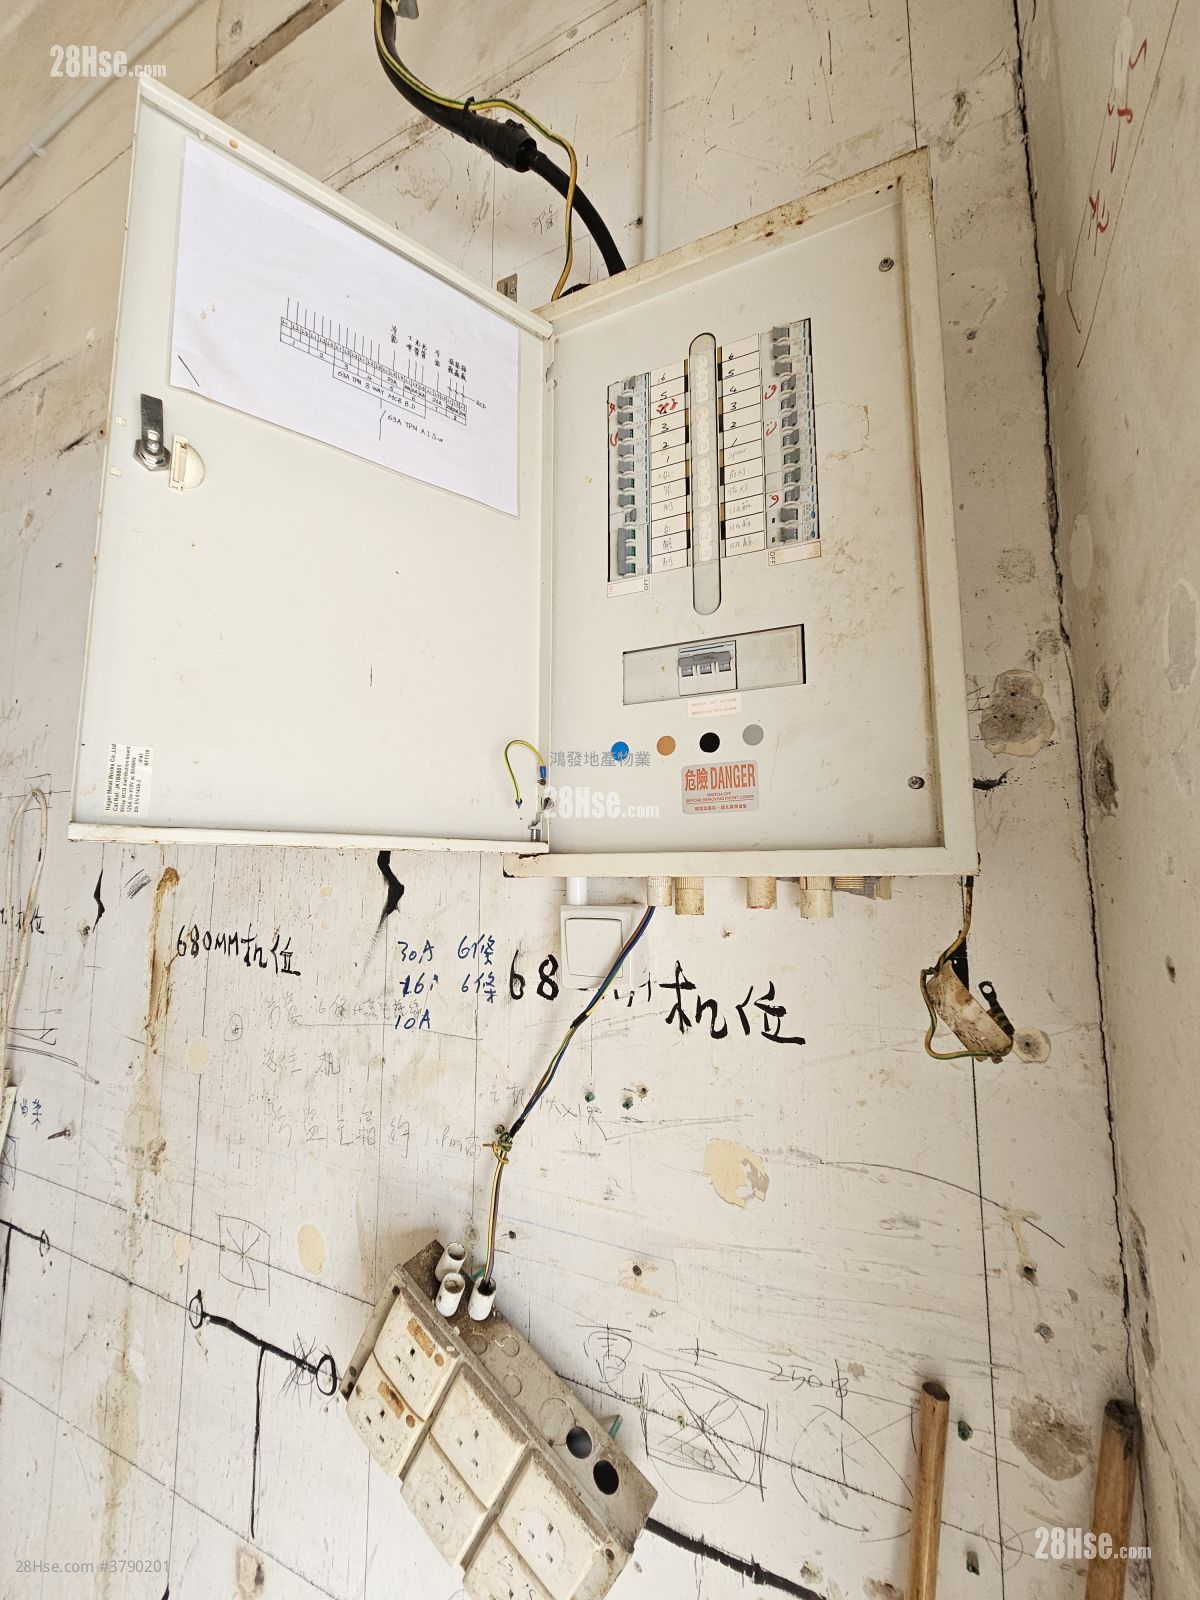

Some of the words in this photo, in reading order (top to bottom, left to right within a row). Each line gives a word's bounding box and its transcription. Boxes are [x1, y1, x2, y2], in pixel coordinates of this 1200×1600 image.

[388, 415, 402, 426] 63A
[405, 421, 418, 431] TPN
[685, 769, 708, 791] 危險
[711, 763, 756, 790] DANGER
[395, 1008, 430, 1030] 10A
